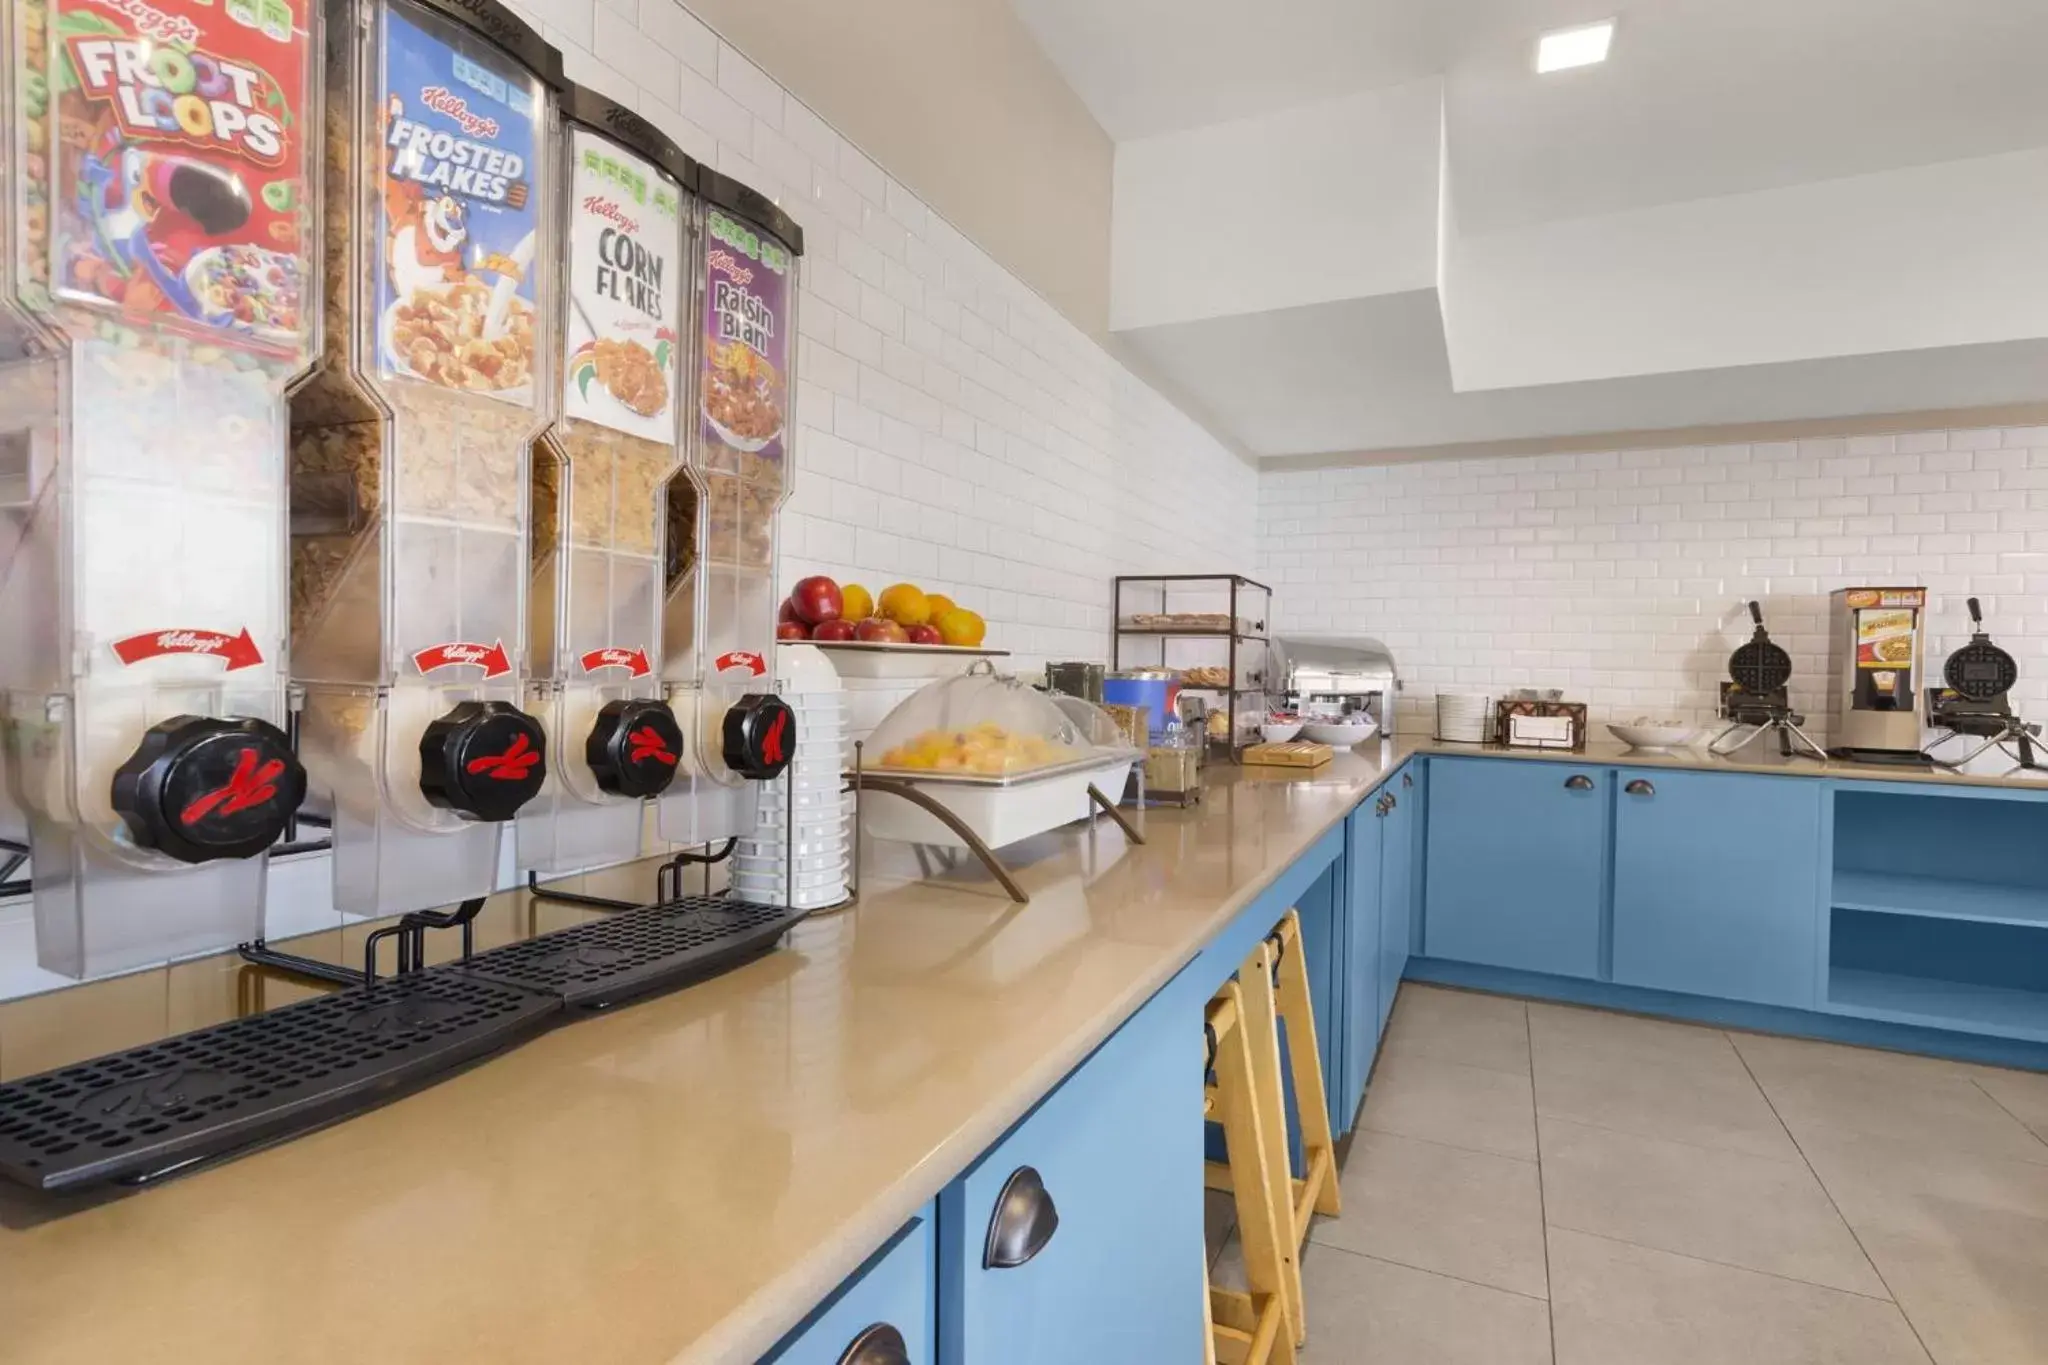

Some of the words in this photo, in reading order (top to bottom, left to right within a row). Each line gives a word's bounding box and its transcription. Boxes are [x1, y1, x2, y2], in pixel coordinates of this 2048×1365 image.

[76, 40, 257, 108] FROOT
[118, 86, 282, 156] LOOPS
[422, 87, 498, 138] Kellogg's
[389, 120, 523, 180] FROSTED
[392, 147, 508, 201] FLAKES
[583, 195, 639, 233] Kellogg's
[599, 227, 663, 292] CORN
[708, 250, 753, 284] Kellogg's
[597, 264, 662, 321] FLAKES
[714, 280, 775, 338] Raisin
[720, 309, 767, 357] Bran
[156, 630, 224, 653] Kellogg's
[442, 644, 486, 663] Kellogg's
